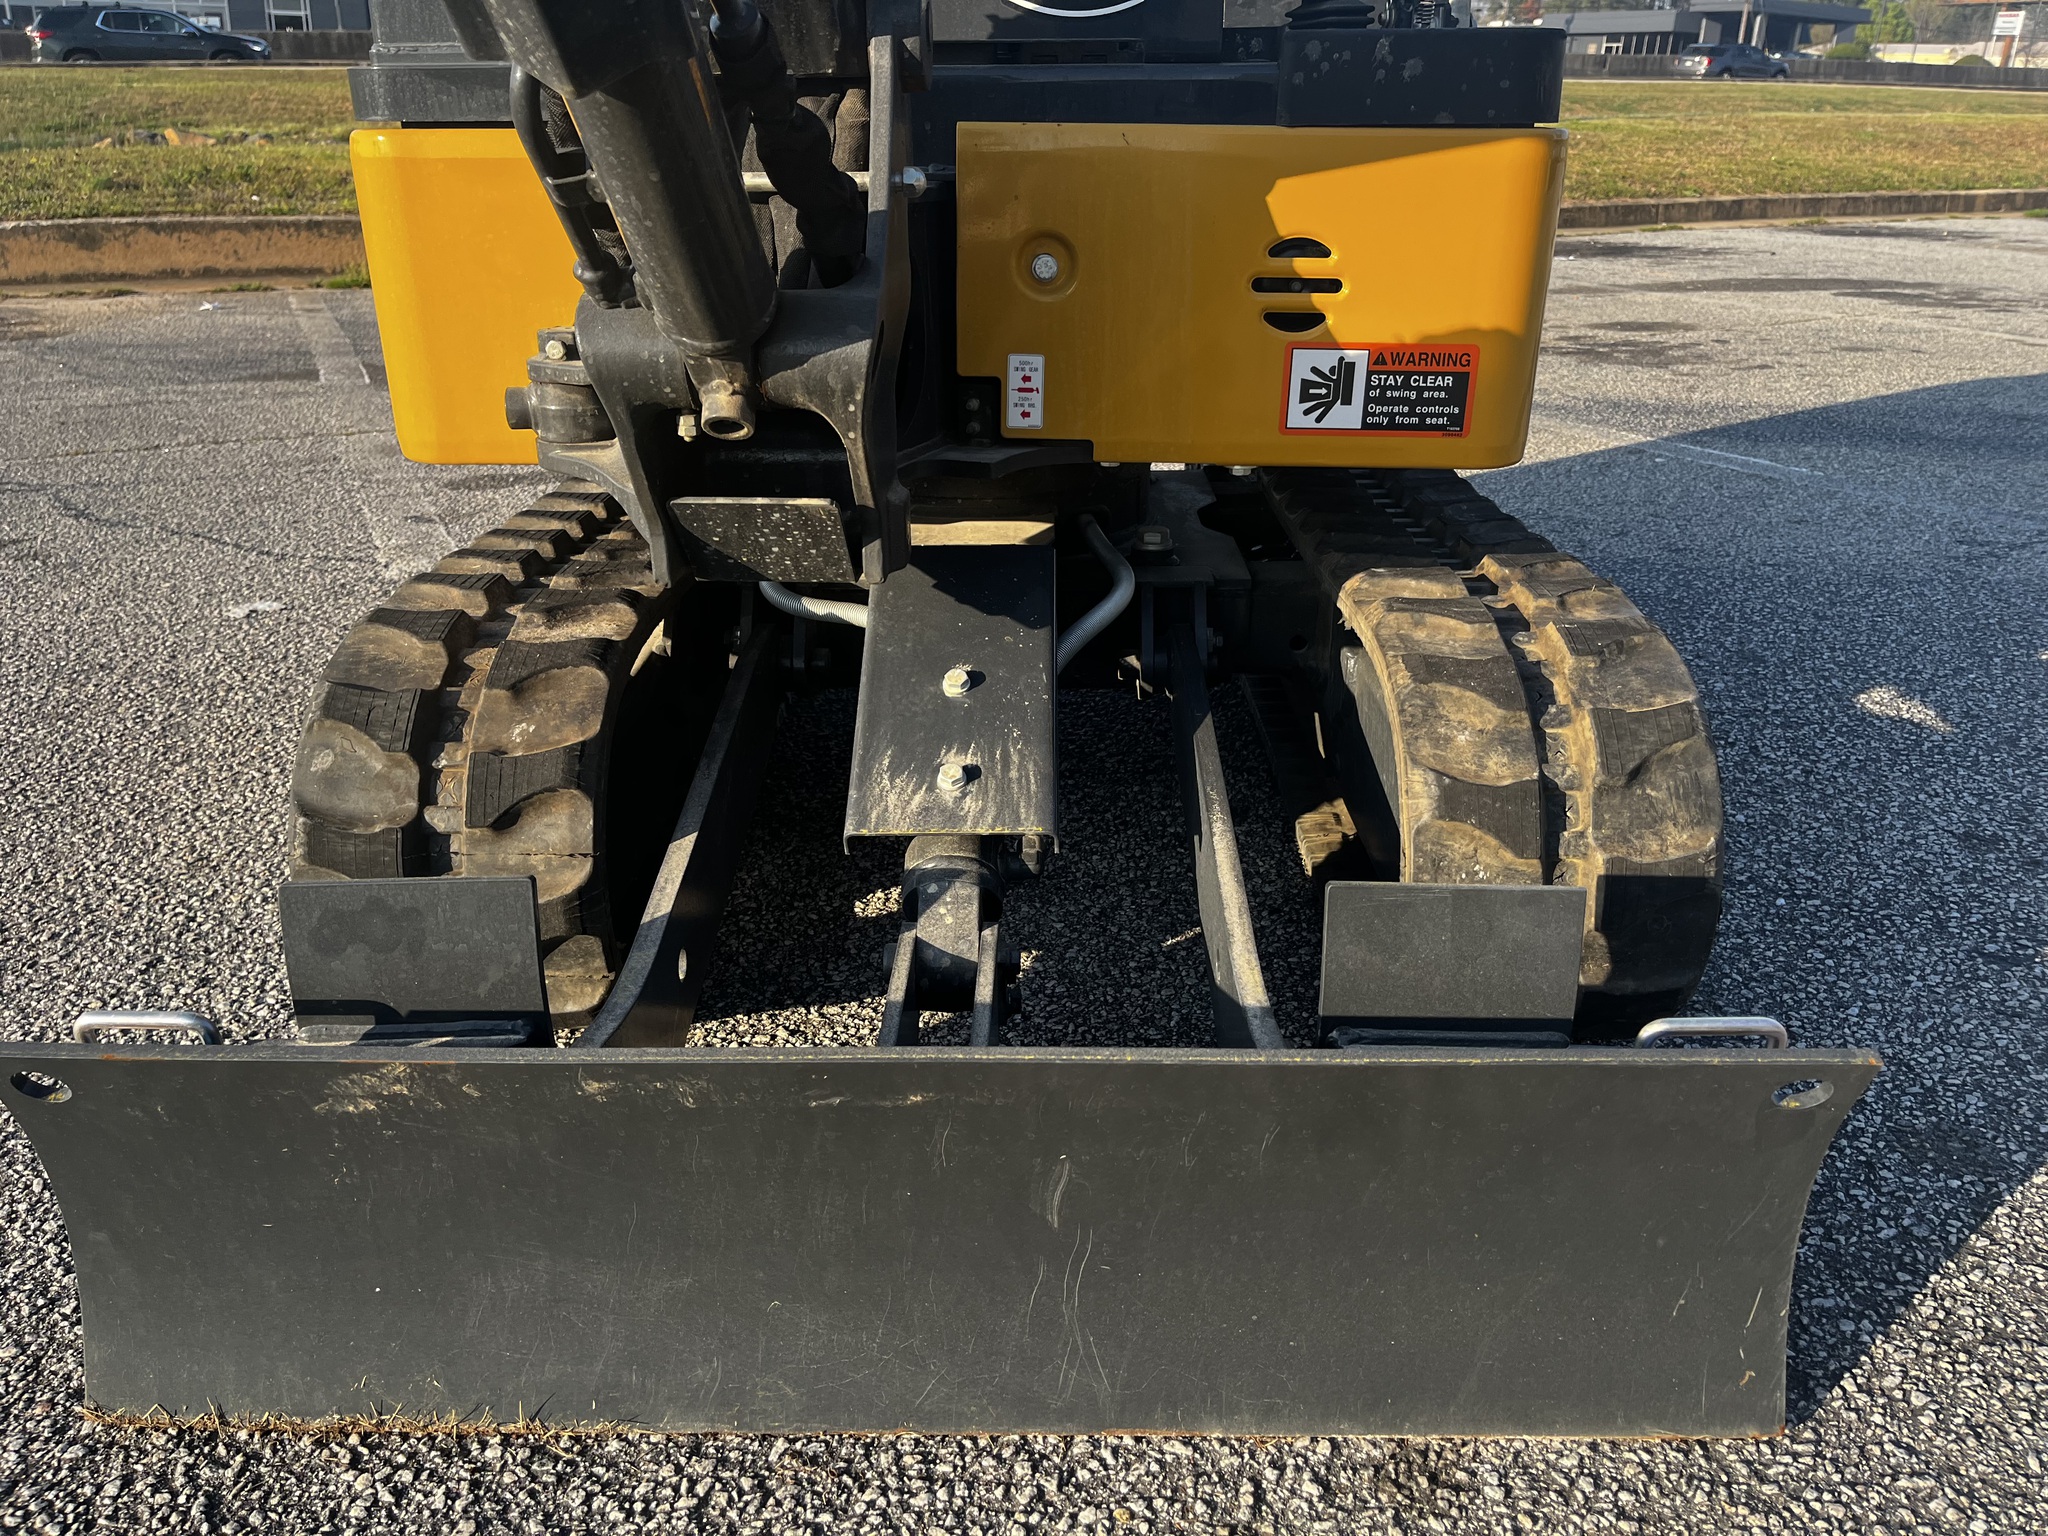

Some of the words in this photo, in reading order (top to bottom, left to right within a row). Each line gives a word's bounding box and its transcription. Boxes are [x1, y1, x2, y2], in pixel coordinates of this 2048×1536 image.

[1390, 351, 1471, 367] WARNING
[1370, 374, 1404, 386] STAY
[1410, 375, 1453, 387] CLEAR
[1369, 388, 1380, 397] of
[1386, 388, 1417, 400] swing
[1367, 403, 1409, 414] Operate
[1415, 405, 1459, 414] controls
[1366, 415, 1389, 426] only
[1395, 415, 1419, 424] from
[1425, 416, 1450, 425] seat.
